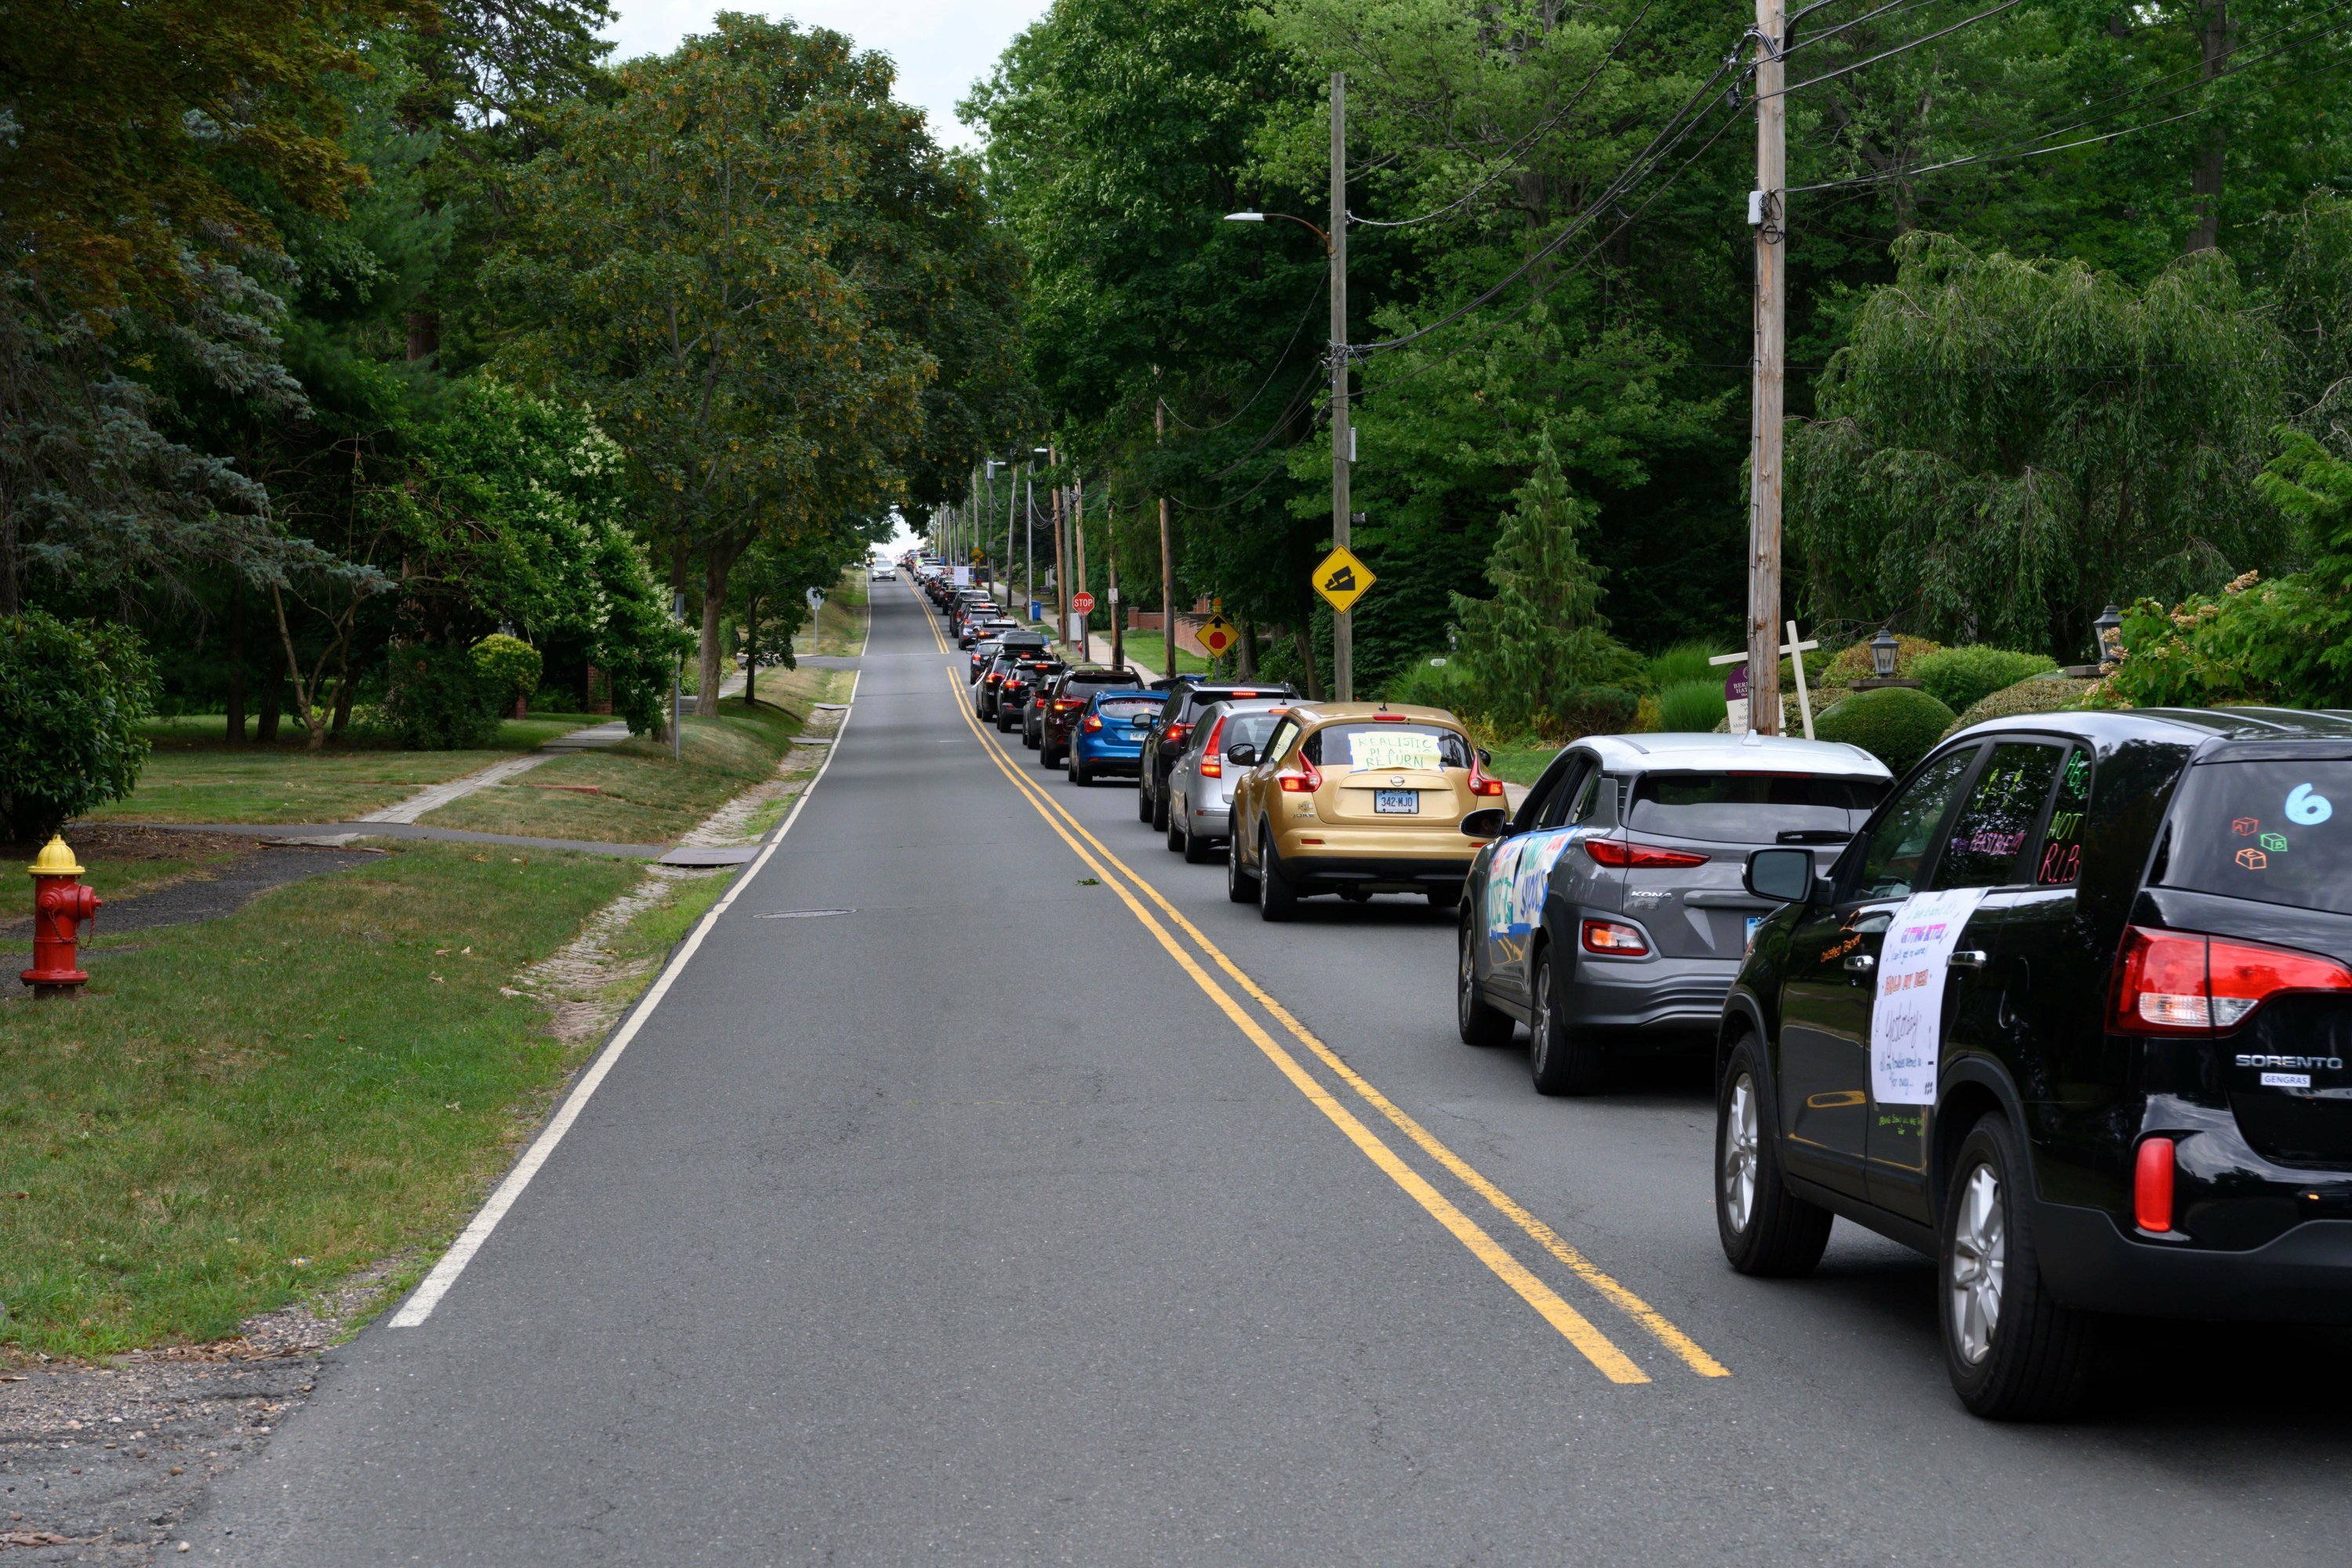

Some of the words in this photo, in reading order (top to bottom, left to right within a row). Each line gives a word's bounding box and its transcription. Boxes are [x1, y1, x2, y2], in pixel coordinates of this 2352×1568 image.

[1074, 598, 1093, 608] STOP
[1359, 737, 1432, 749] REALISTIC
[1366, 754, 1423, 768] RETURN
[2285, 782, 2333, 826] 6
[2046, 810, 2083, 840] NOT
[1631, 891, 1672, 899] KONA
[2235, 1054, 2343, 1069] SORENTO
[2264, 1075, 2308, 1085] GENGRAS
